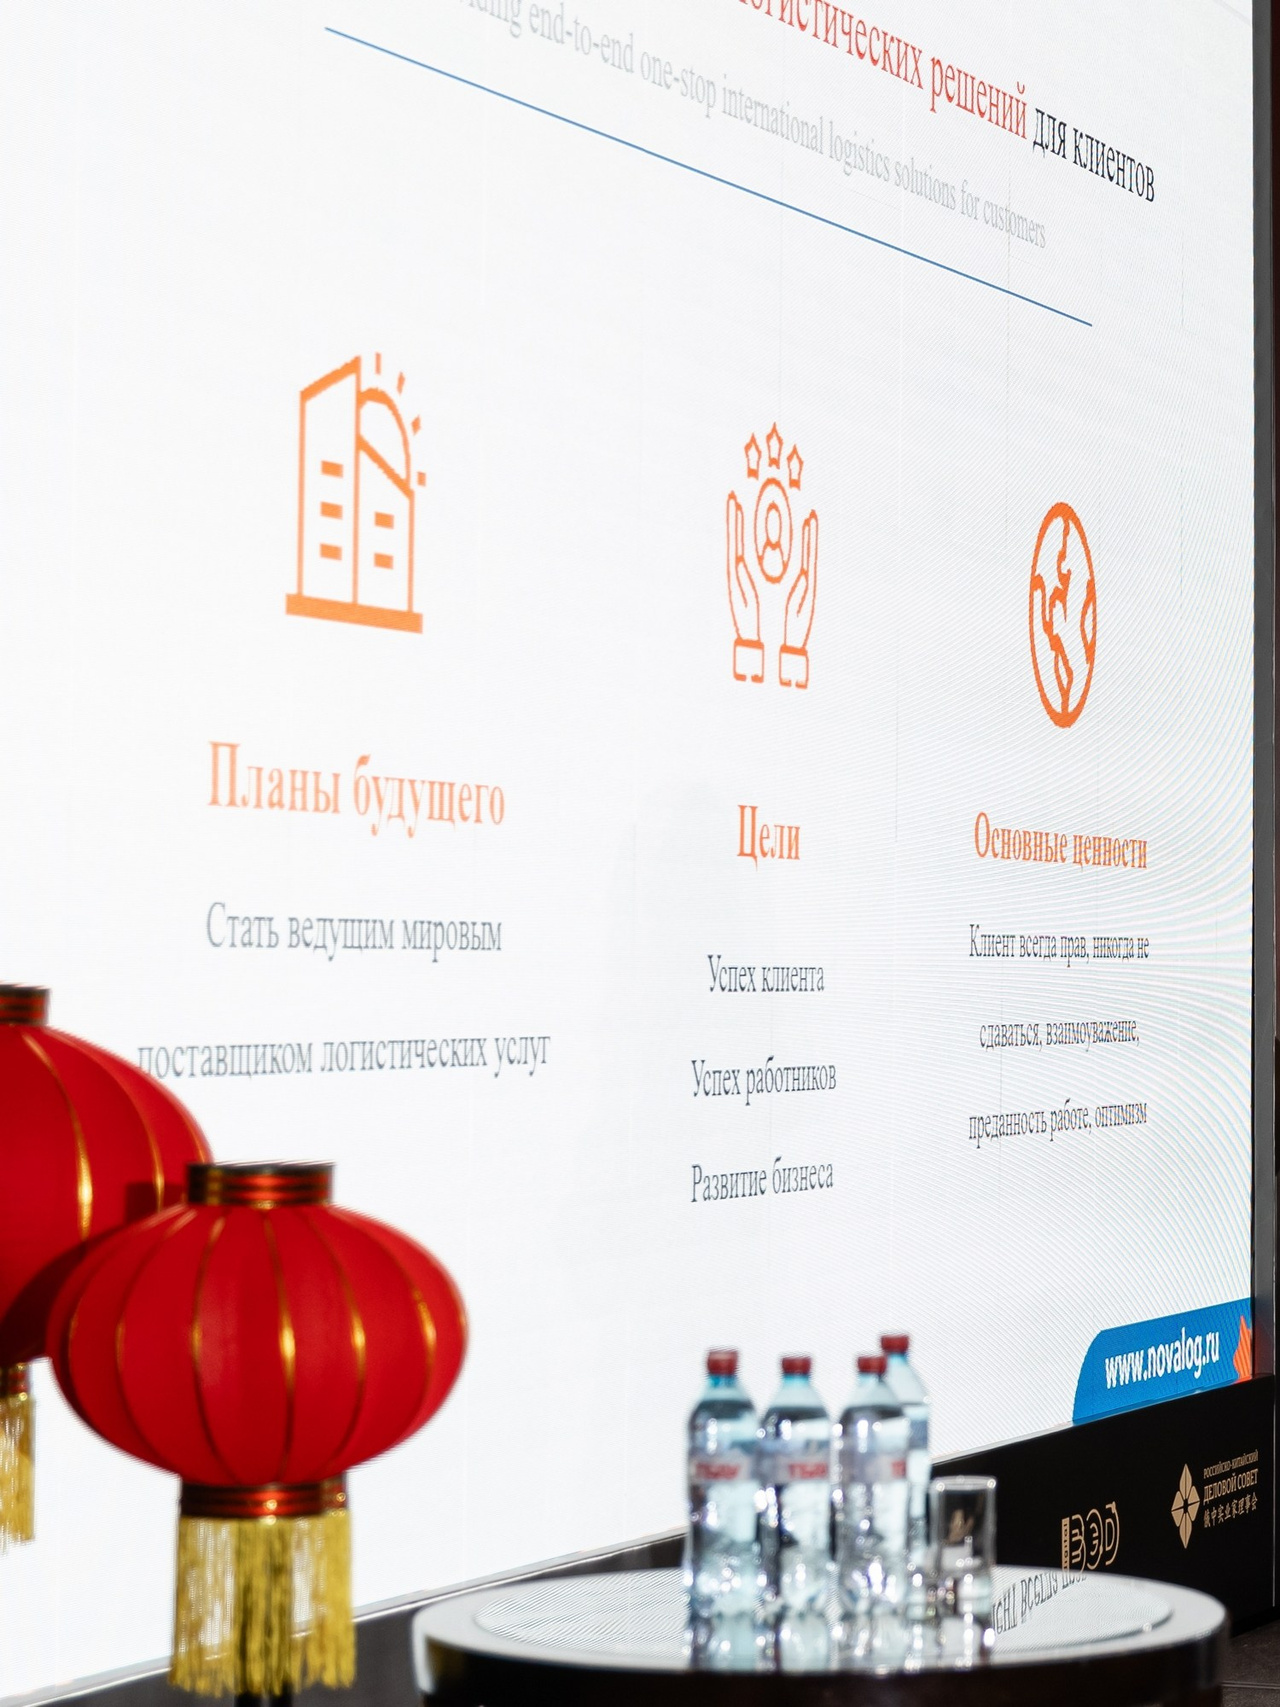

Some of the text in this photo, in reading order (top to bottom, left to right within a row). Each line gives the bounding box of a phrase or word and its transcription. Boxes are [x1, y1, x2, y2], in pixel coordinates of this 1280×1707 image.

[529, 2, 634, 74] end-to-end
[640, 50, 717, 119] one-stop
[722, 73, 824, 155] international
[828, 120, 890, 183] logistics
[894, 156, 956, 210] solutions
[961, 179, 980, 221] for
[983, 198, 1047, 249] customers
[930, 56, 1027, 140] решений
[1033, 107, 1067, 159] для
[1073, 127, 1155, 202] клиентов
[207, 740, 505, 839] Планы будущего
[736, 804, 801, 871] Цели
[974, 811, 1148, 872] Основные ценности
[206, 902, 502, 963] Стать ведущим мировым
[969, 924, 1150, 967] Клиент всегда прав, никогда не
[707, 954, 825, 992] Успех клиента
[137, 1035, 551, 1080] поставщиком логистических услуг
[979, 1020, 1140, 1052] сдаваться, взаимоуважение,
[691, 1056, 837, 1105] Успех работников
[969, 1098, 1148, 1149] преданность работе, оптимизм
[691, 1156, 834, 1202] Развитие бизнеса
[1105, 1327, 1219, 1389] www.novalog.ru
[1203, 1468, 1259, 1506] ДЕЛОВОЙ СОВЕТ
